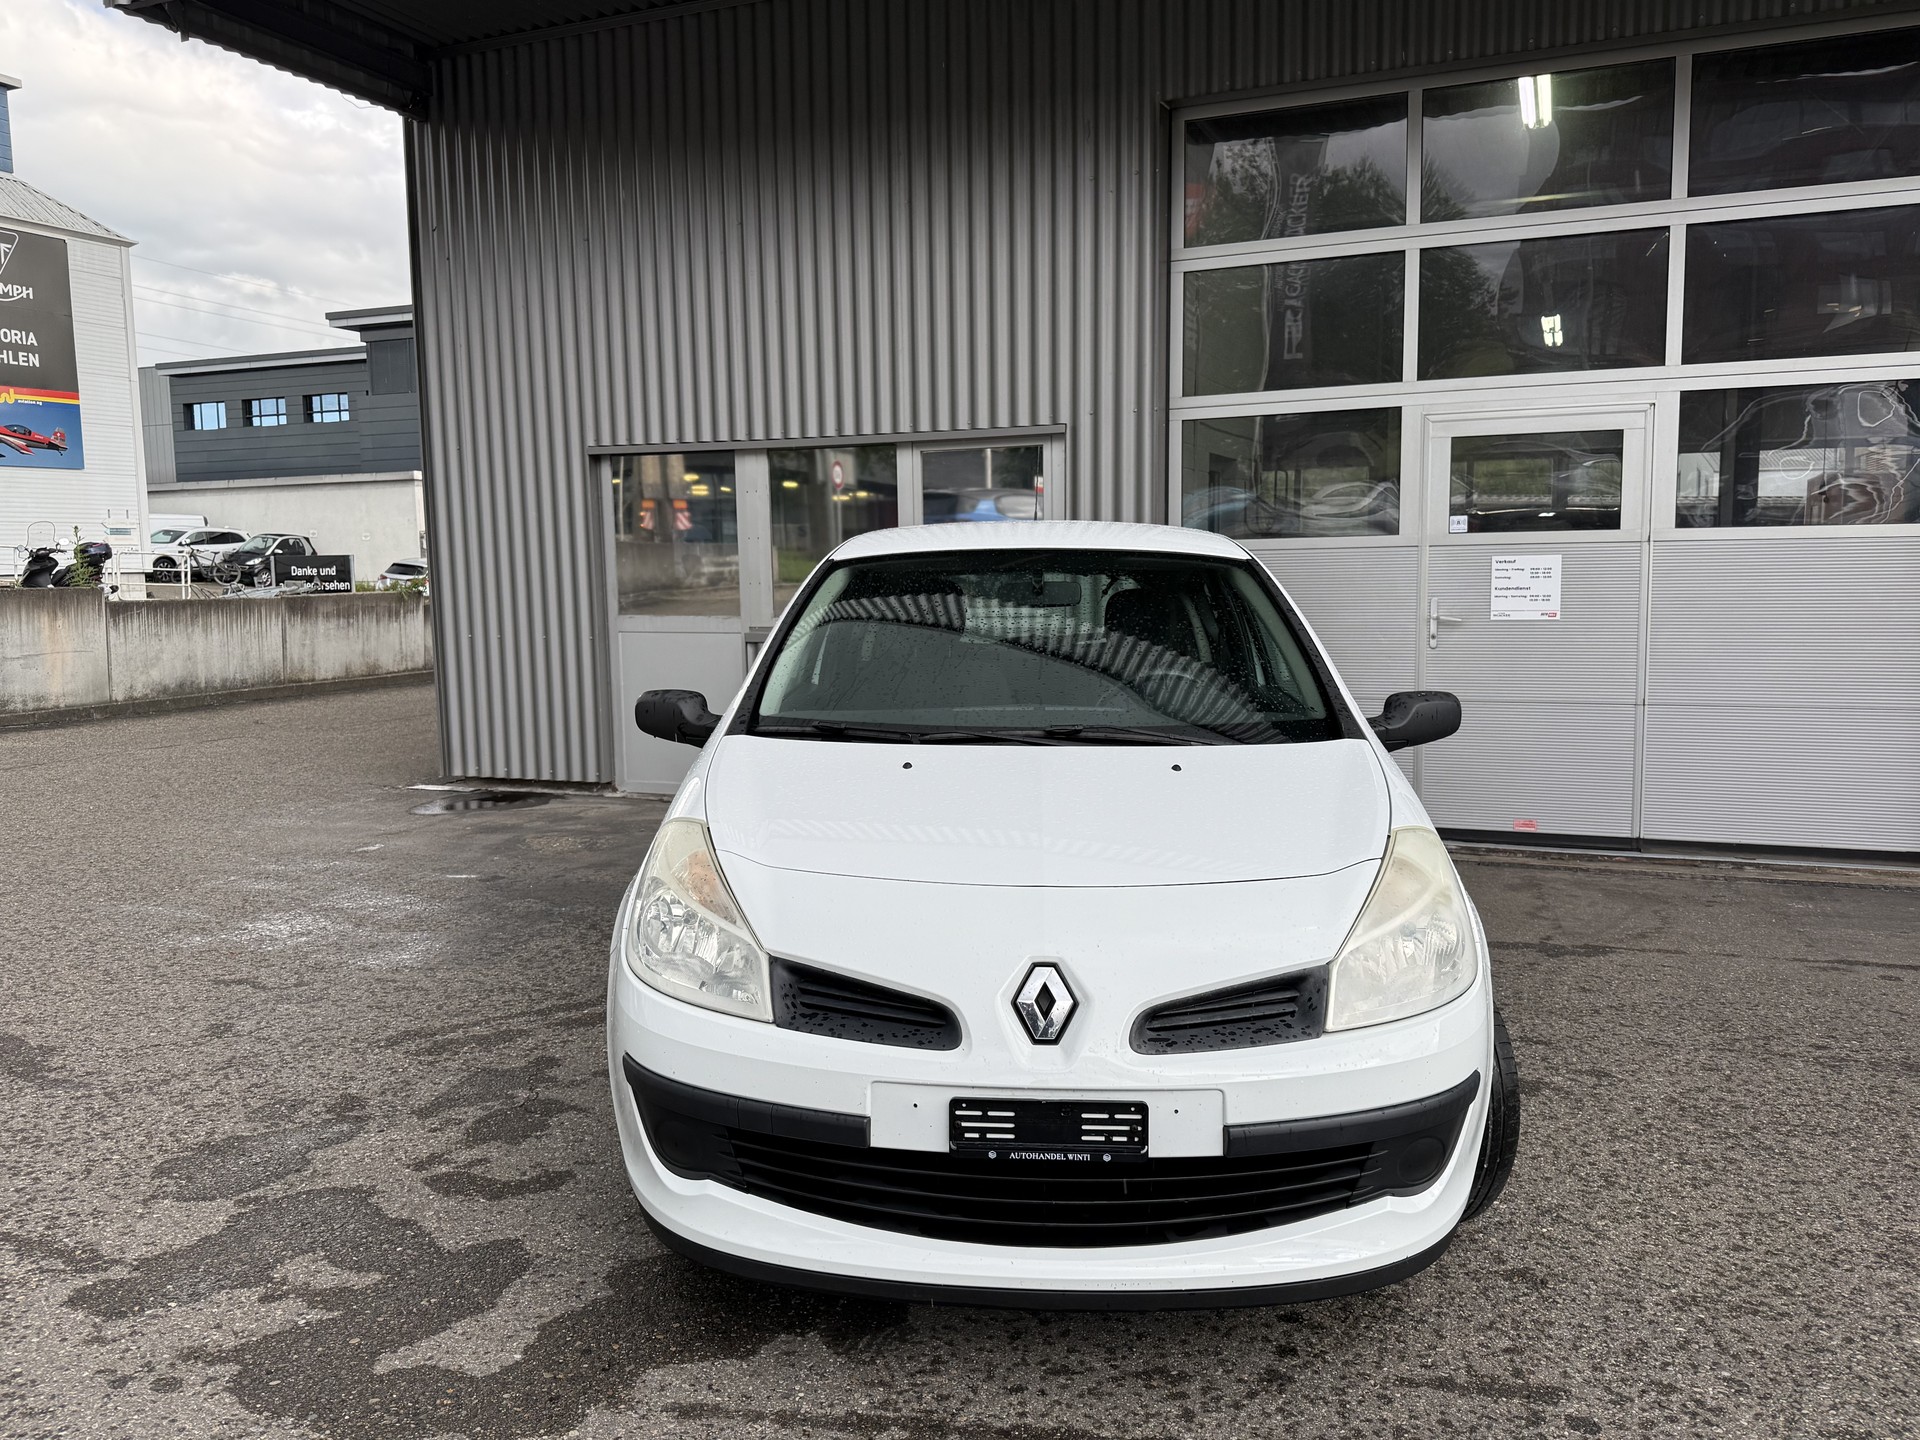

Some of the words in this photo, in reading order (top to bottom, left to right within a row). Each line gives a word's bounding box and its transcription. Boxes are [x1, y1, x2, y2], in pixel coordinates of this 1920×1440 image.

[0, 282, 33, 300] MPH
[0, 328, 38, 346] ORIA
[291, 565, 318, 576] Danke
[319, 565, 336, 576] und
[1009, 1152, 1066, 1160] AUTOHANDEL
[1067, 1153, 1091, 1161] WINTI
